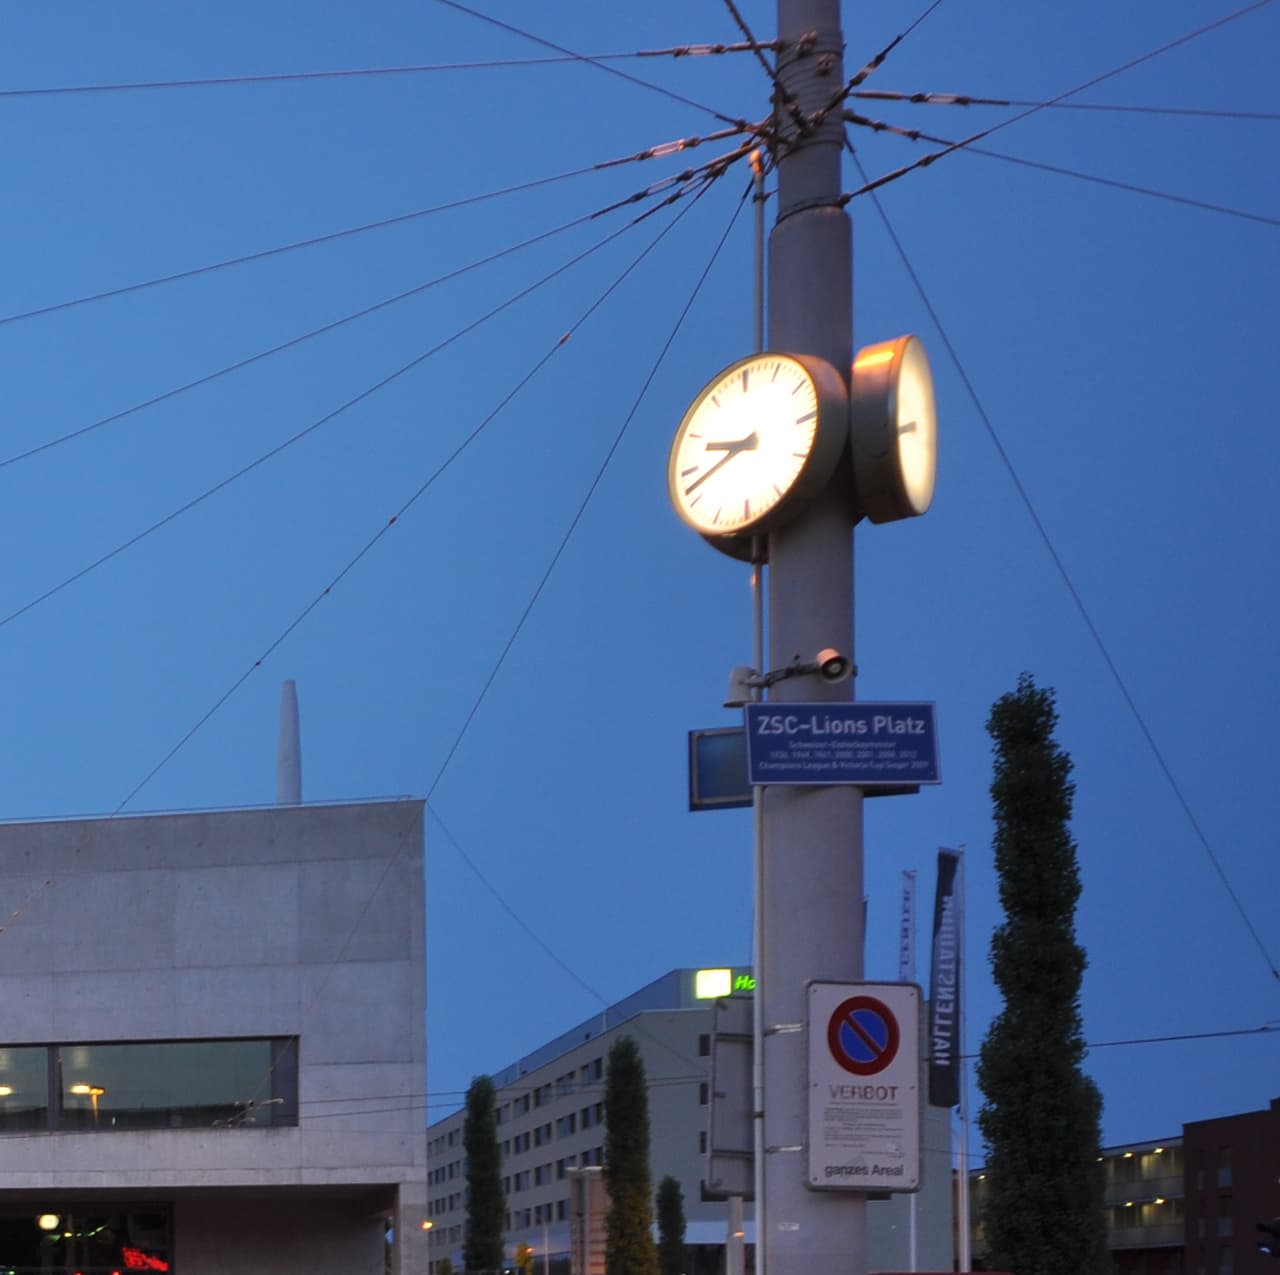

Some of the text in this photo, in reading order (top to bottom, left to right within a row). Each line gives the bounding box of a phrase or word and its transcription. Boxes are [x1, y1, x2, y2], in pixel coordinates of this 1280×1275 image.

[757, 715, 926, 734] ZSC-Lions Platz
[828, 1084, 898, 1100] VERBOT
[824, 1164, 904, 1178] ganzes Areal
